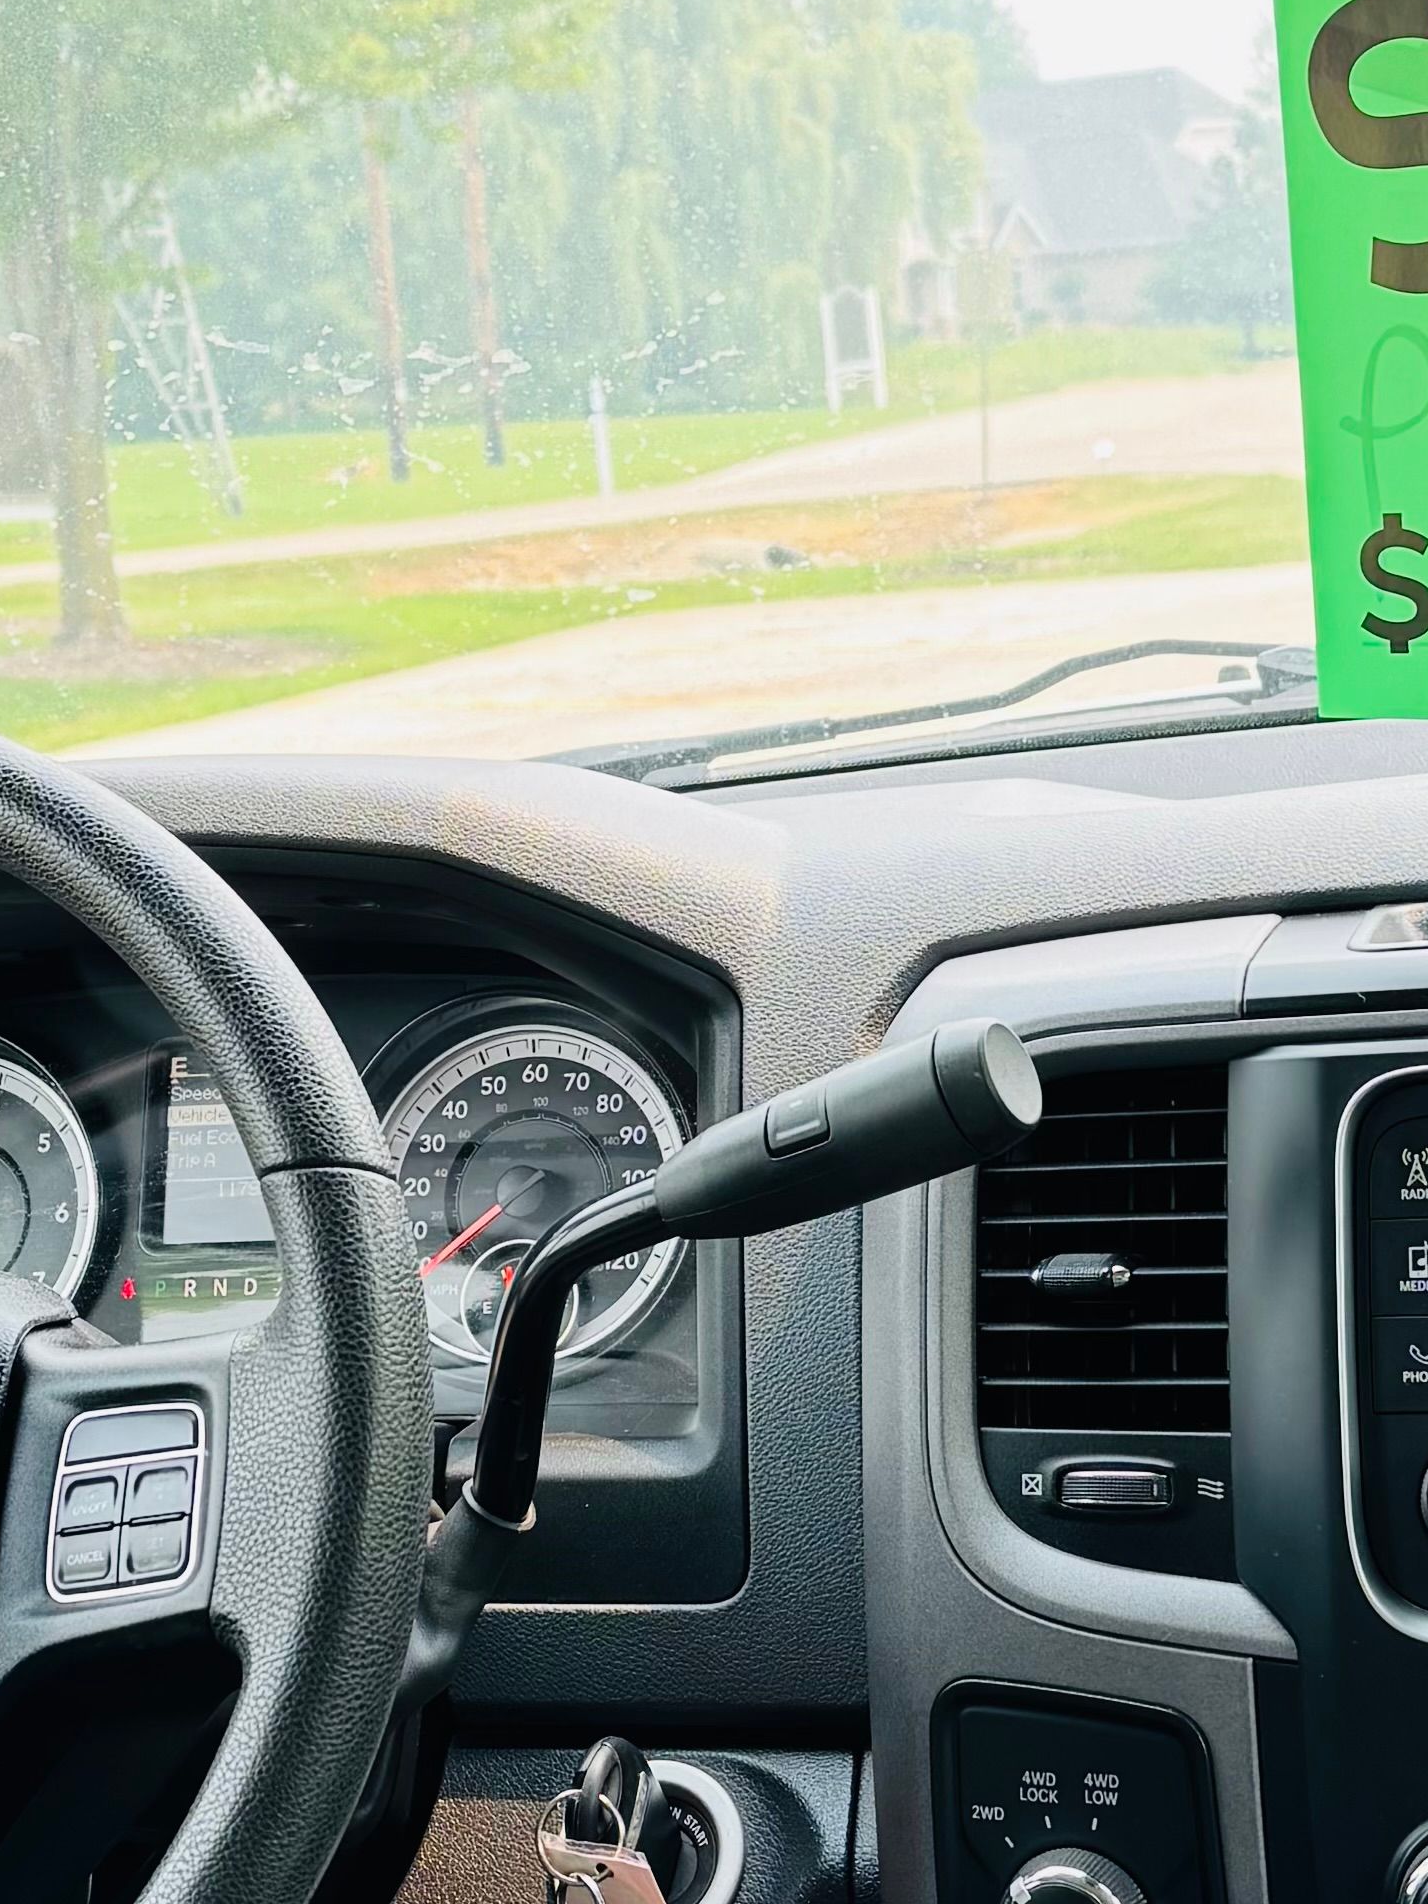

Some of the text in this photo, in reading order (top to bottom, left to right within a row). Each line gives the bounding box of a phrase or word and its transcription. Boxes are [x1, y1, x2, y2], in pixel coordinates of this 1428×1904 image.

[171, 1057, 187, 1078] E
[522, 1064, 548, 1082] 60
[481, 1077, 506, 1095] 50
[564, 1072, 590, 1091] 70
[442, 1101, 468, 1119] 40
[596, 1094, 623, 1113] 80
[171, 1108, 228, 1122] Vehicle
[37, 1133, 51, 1153] 5
[169, 1132, 201, 1146] Fuel
[419, 1134, 445, 1153] 30
[619, 1126, 647, 1145] 90
[404, 1178, 430, 1197] 20
[54, 1202, 69, 1224] 6
[155, 1278, 258, 1297] P R N D
[483, 1301, 492, 1314] E
[67, 1551, 104, 1565] CANCEL
[1021, 1771, 1057, 1787] 4WD
[1084, 1773, 1119, 1789] 4WD
[1019, 1788, 1058, 1804] LOCK
[1085, 1790, 1118, 1805] LOW
[972, 1805, 1004, 1821] 2WD
[684, 1814, 709, 1847] START
